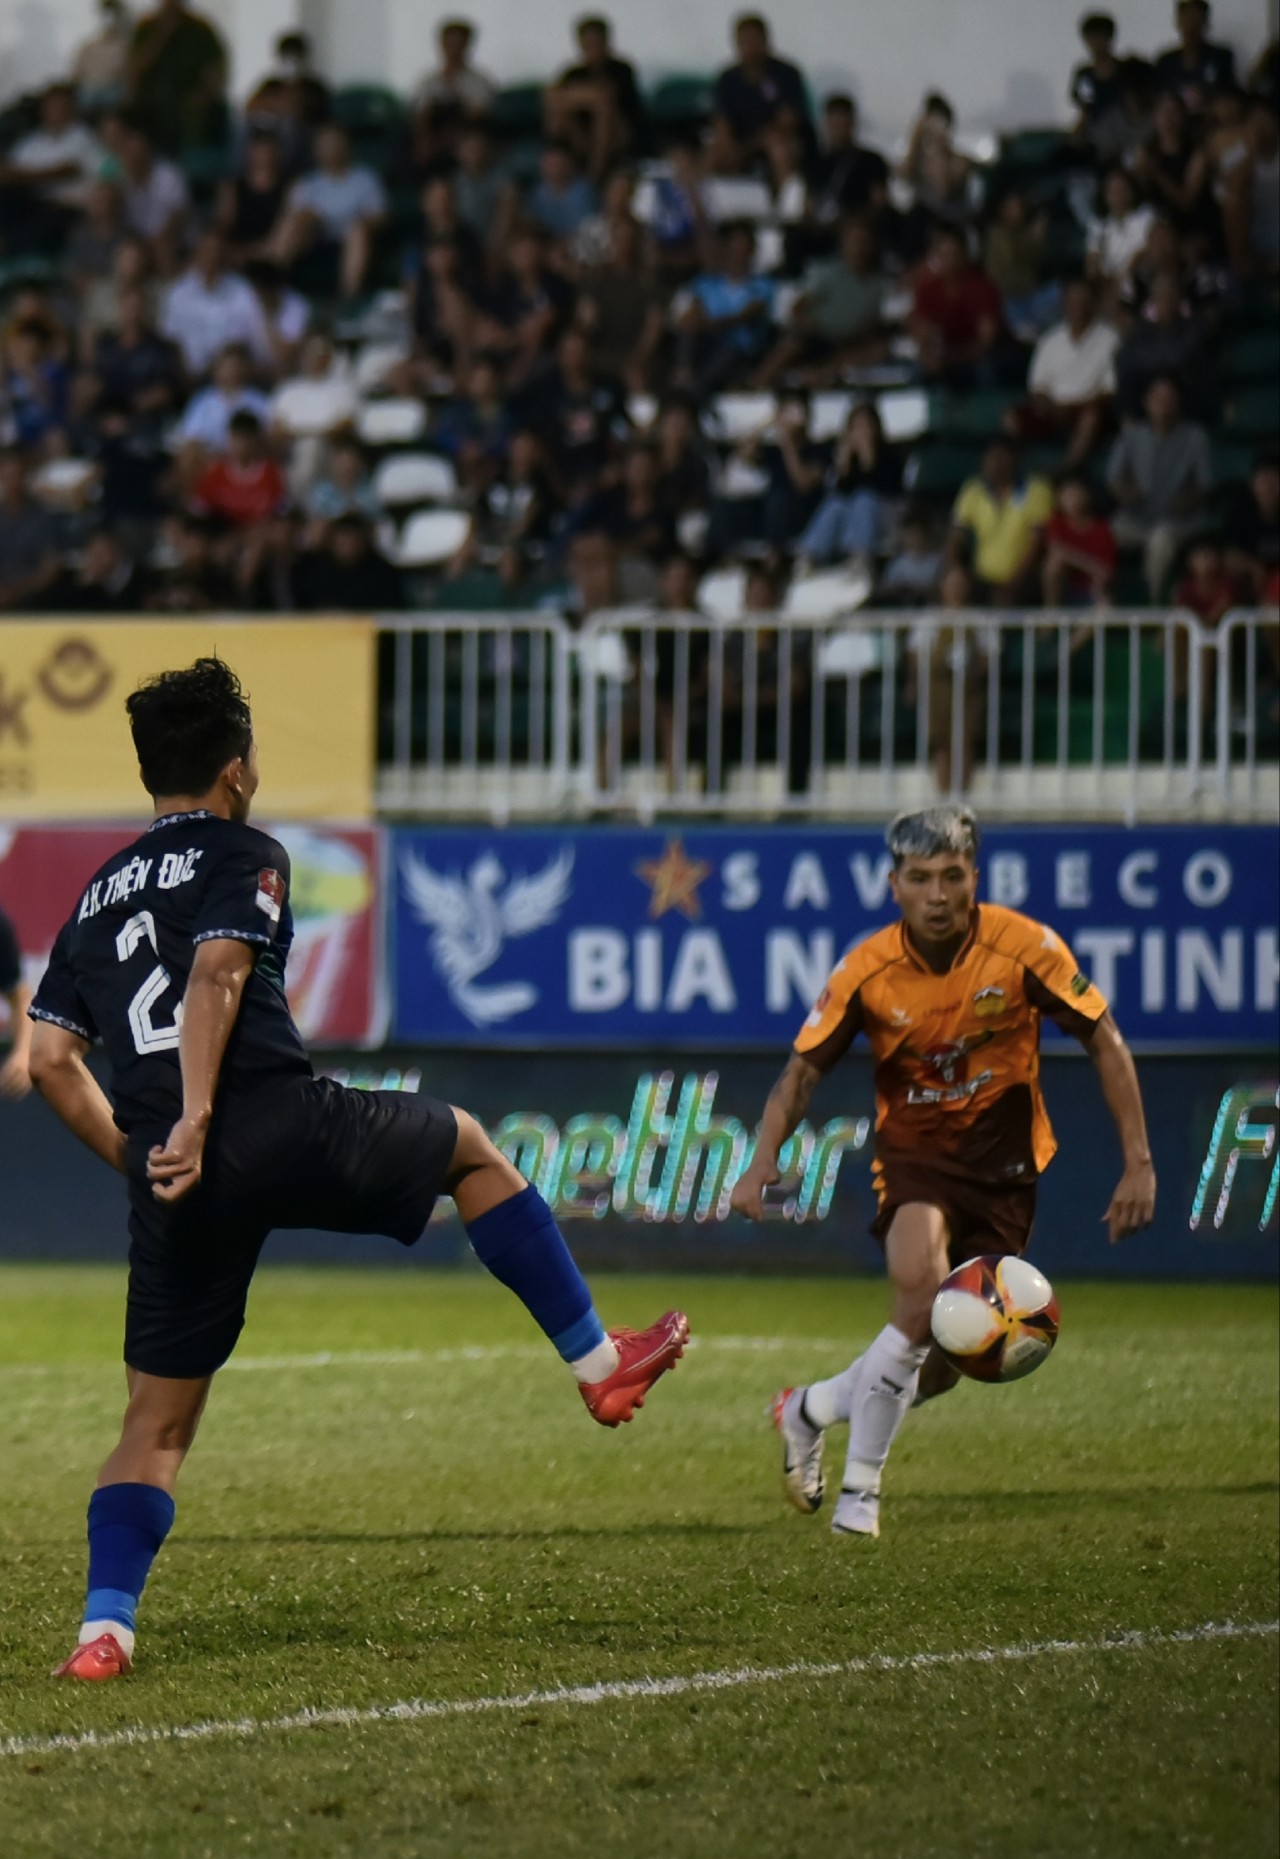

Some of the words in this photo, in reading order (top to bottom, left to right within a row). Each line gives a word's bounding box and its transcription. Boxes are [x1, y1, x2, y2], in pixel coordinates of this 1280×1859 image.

[721, 850, 1233, 909] SAVBECO
[115, 910, 183, 1055] 2
[568, 928, 738, 1012] BIA
